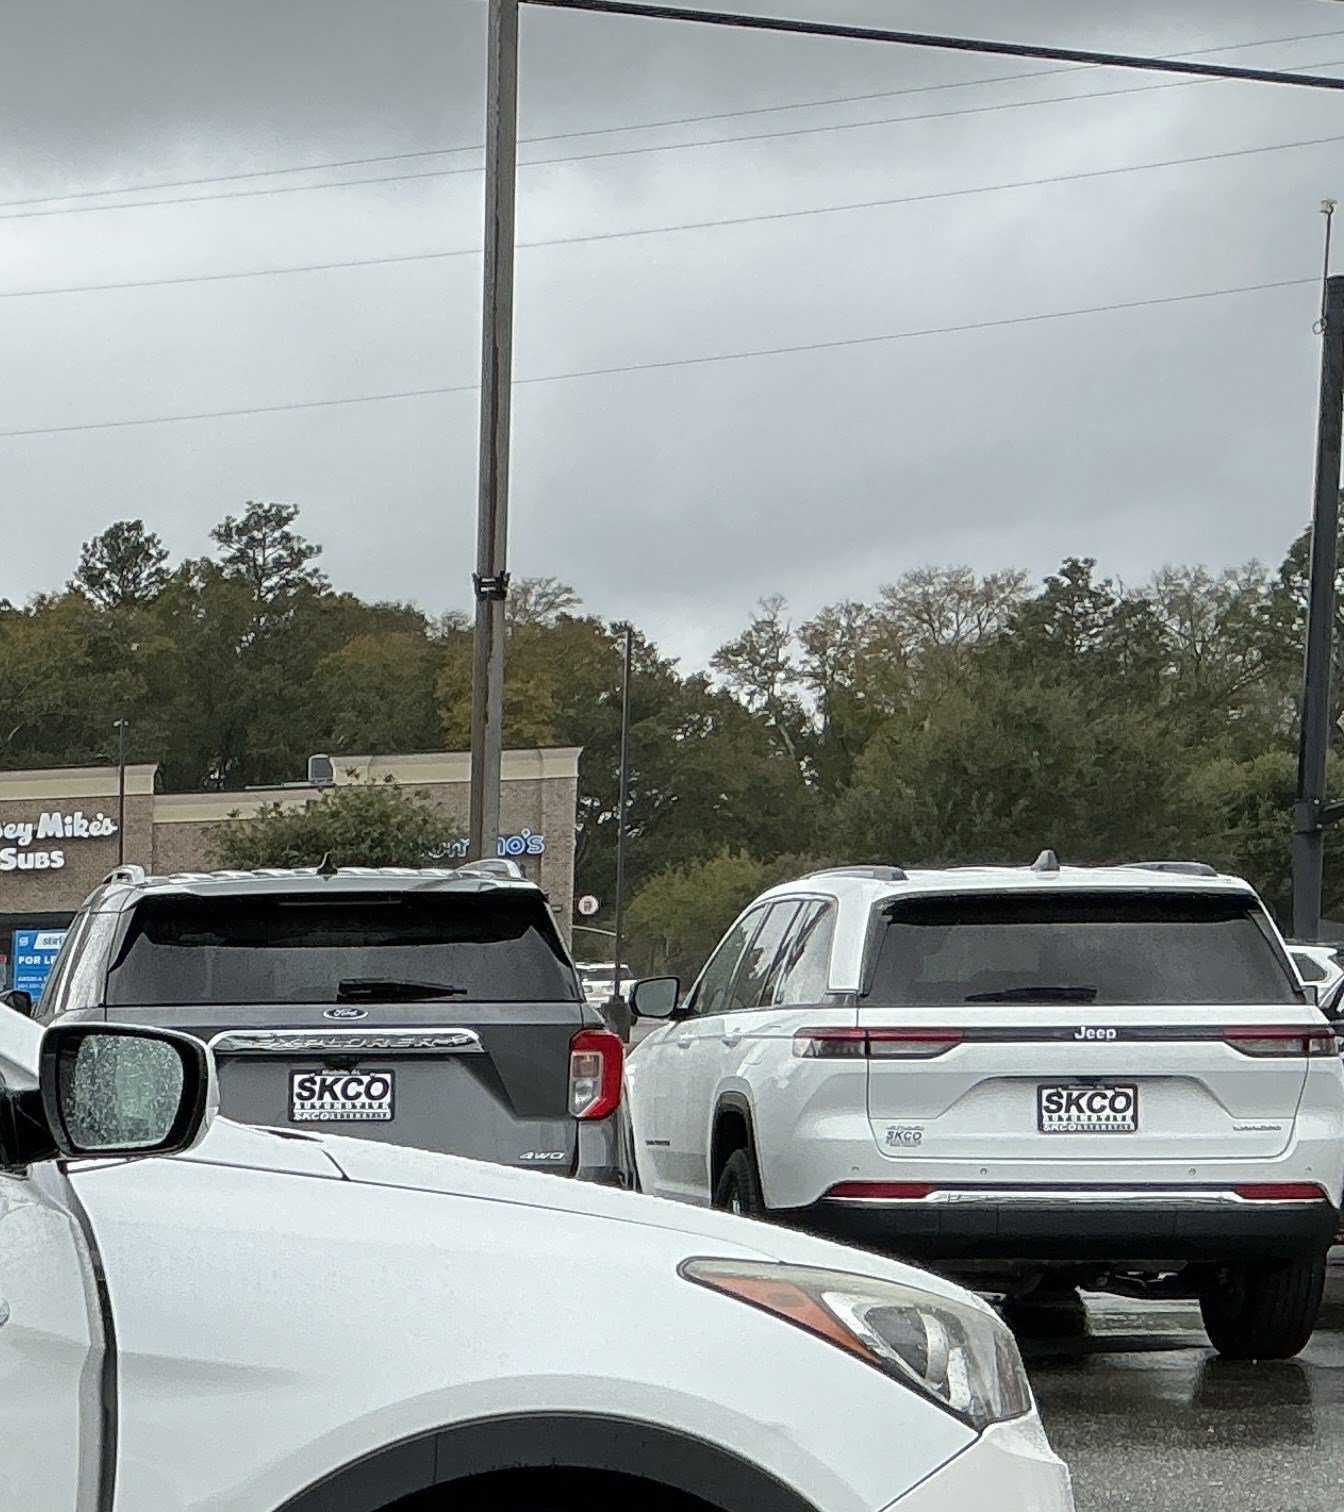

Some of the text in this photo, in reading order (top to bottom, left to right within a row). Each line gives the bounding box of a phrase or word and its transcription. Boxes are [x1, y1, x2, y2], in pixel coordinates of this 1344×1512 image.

[36, 811, 118, 838] Mike's
[18, 955, 41, 965] FOR
[333, 1007, 359, 1018] Ford
[1074, 1026, 1117, 1040] Jeep
[295, 1076, 390, 1101] SKCO
[1043, 1091, 1132, 1114] SKCO
[886, 1131, 922, 1140] SKCO
[519, 1152, 565, 1160] 4WD
